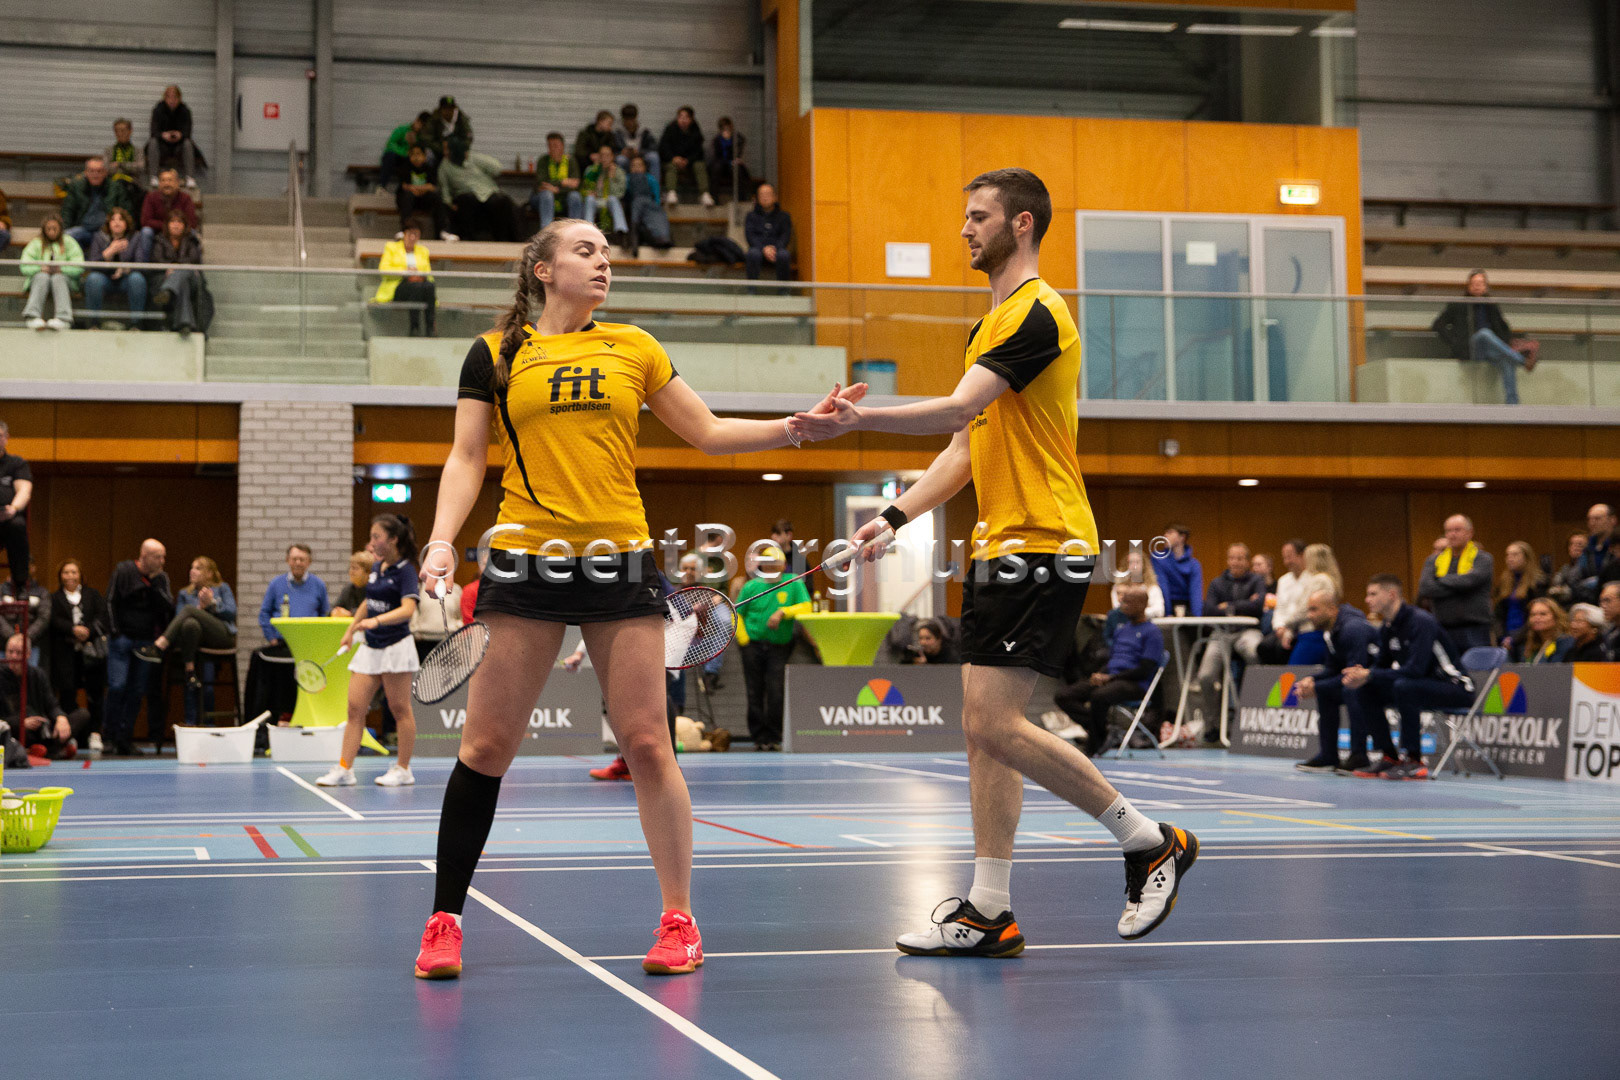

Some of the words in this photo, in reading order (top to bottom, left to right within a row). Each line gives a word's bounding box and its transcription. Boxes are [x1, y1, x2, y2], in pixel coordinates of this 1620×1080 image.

[550, 401, 611, 415] sportbalsem
[439, 707, 573, 729] VAOLK
[819, 705, 945, 726] VANDEKOLK
[1240, 706, 1320, 735] VANDEKOLK
